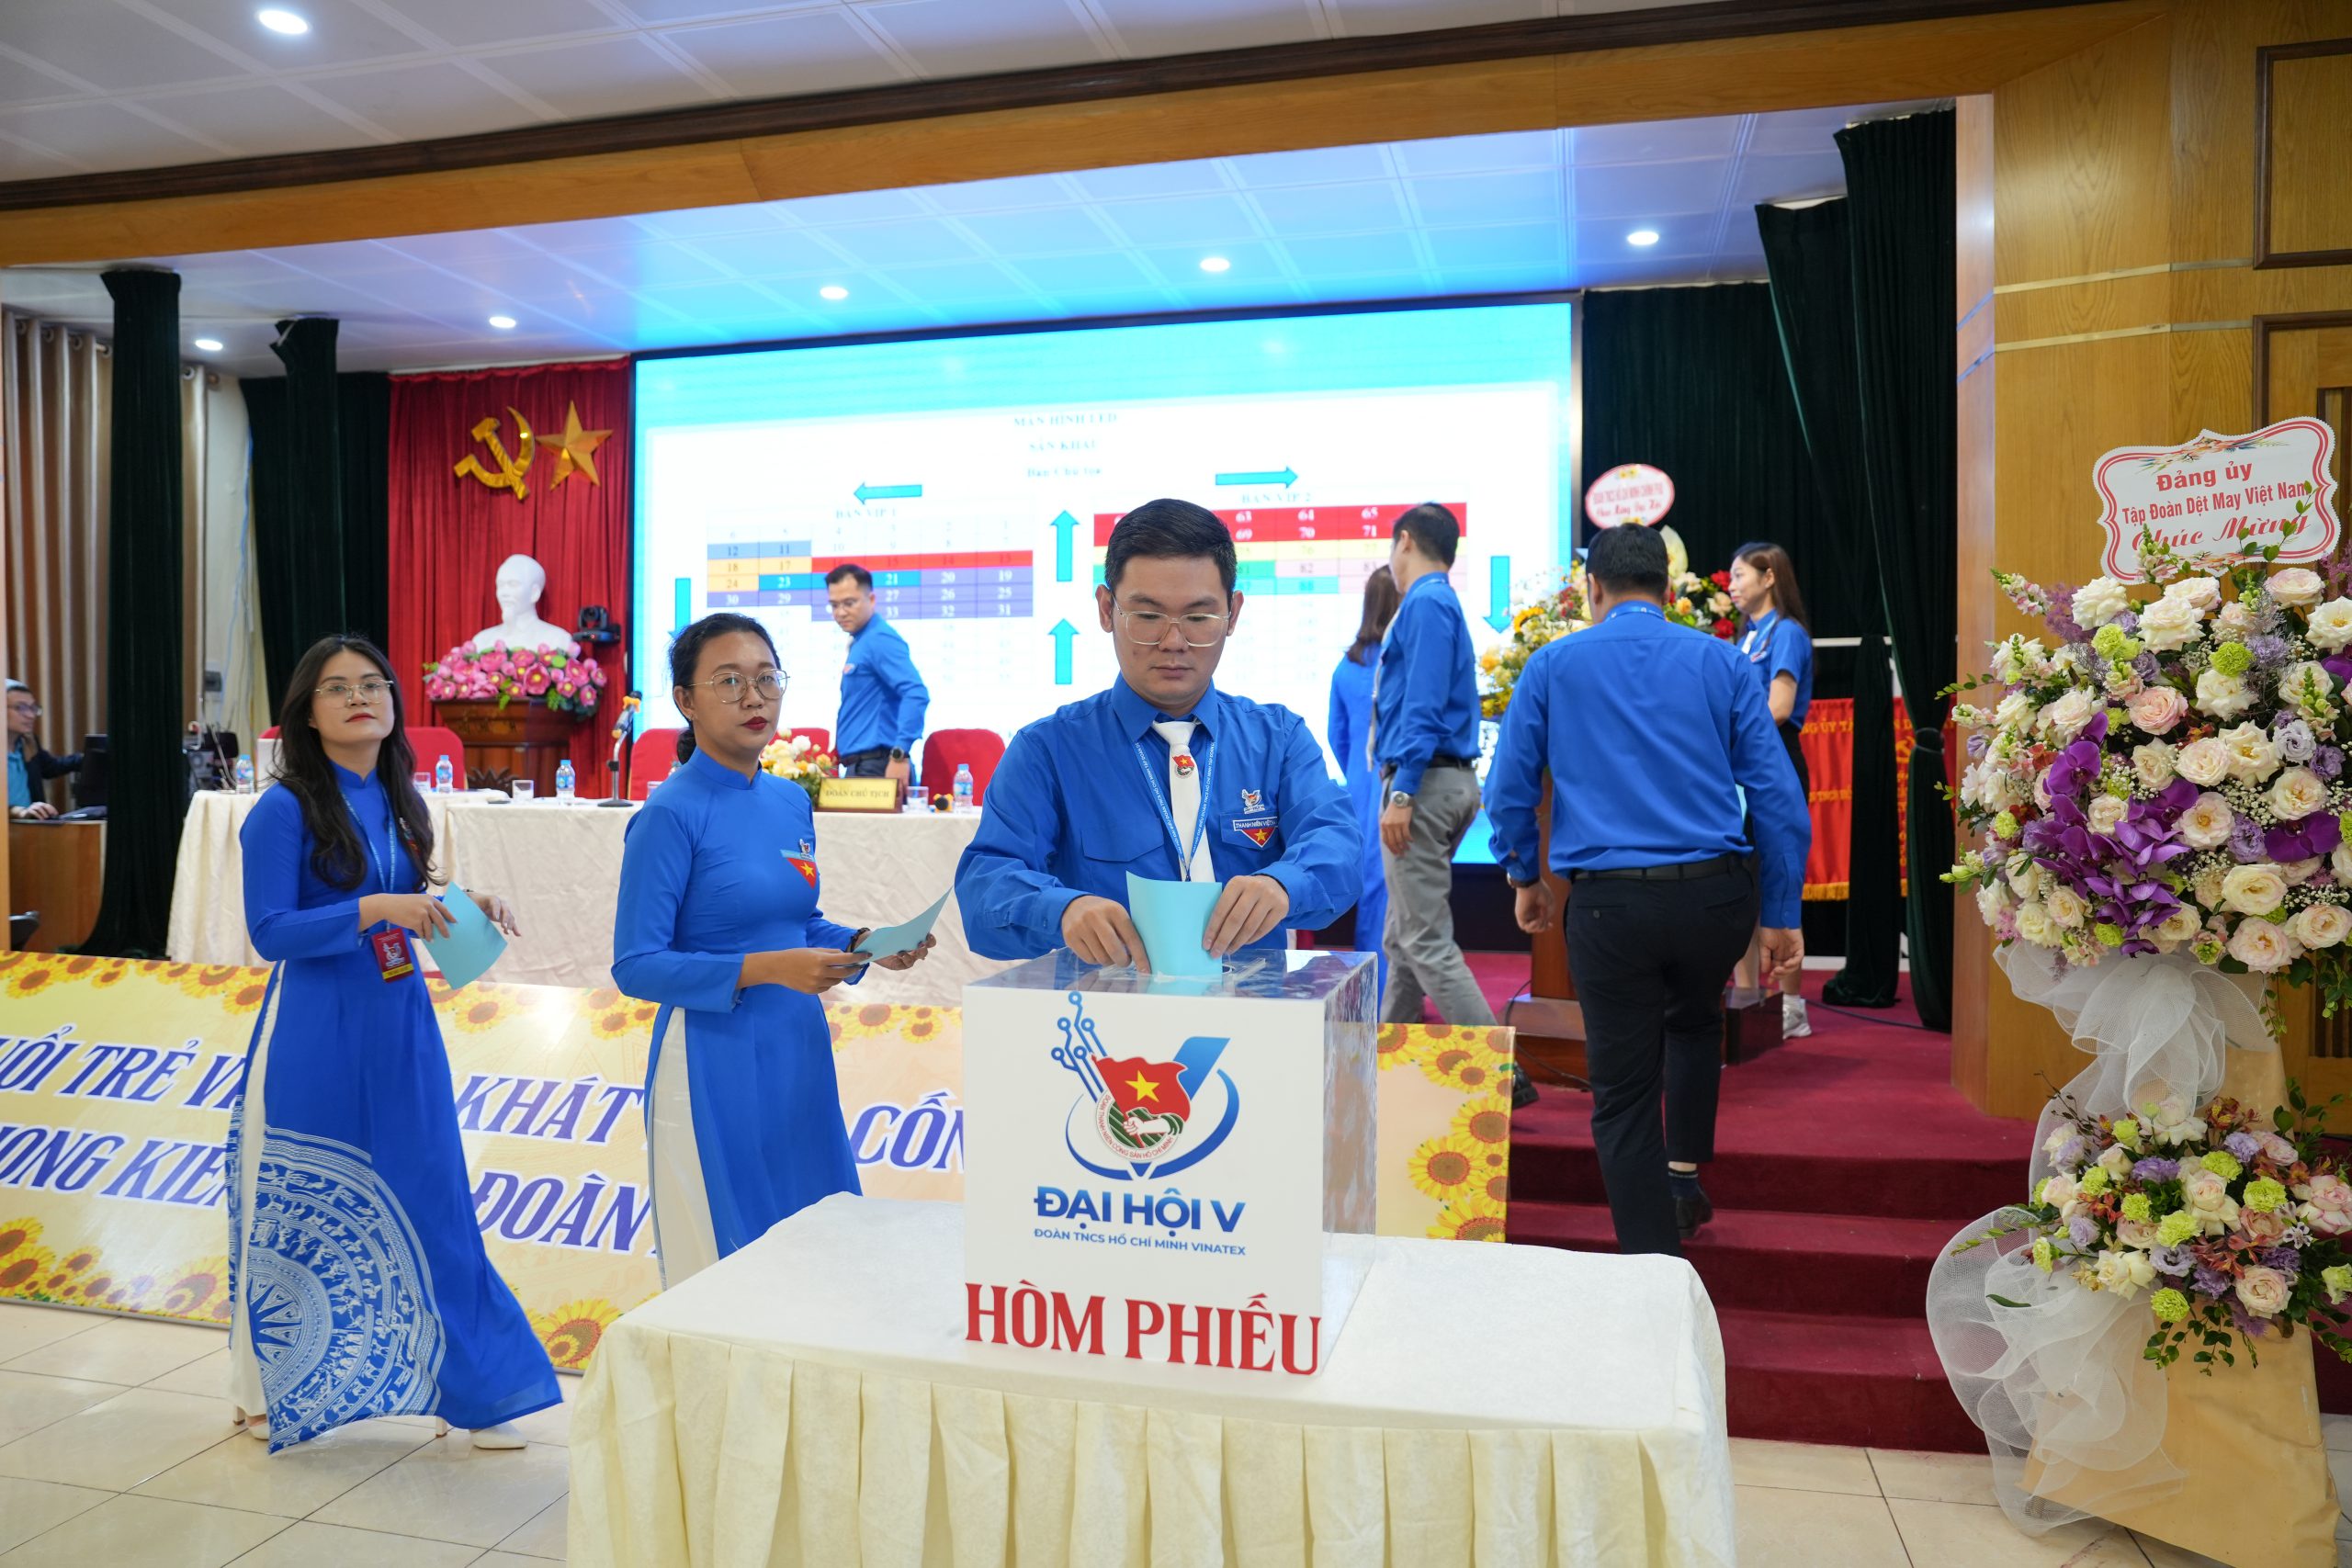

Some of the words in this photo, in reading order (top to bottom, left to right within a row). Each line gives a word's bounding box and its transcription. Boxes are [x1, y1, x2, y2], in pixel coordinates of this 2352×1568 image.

[2156, 469, 2217, 491] Đảng
[2226, 461, 2253, 481] ủy
[2122, 507, 2146, 525] Tập
[2150, 502, 2183, 520] Đoàn
[2187, 496, 2208, 516] Dệt
[2213, 491, 2241, 512] May
[2245, 487, 2274, 507] Việt
[2278, 481, 2311, 498] Nam
[1298, 526, 1316, 538] 70
[1362, 525, 1377, 537] 71
[727, 546, 739, 557] 12
[727, 562, 739, 572] 18
[779, 560, 791, 570] 17
[1300, 563, 1313, 574] 82
[727, 579, 738, 589] 24
[885, 573, 899, 585] 21
[941, 571, 956, 584] 20
[999, 570, 1012, 582] 19
[886, 589, 899, 603] 27
[941, 588, 956, 601] 26
[998, 604, 1012, 616] 31
[60, 1040, 198, 1101] TRẺ
[455, 1076, 645, 1143] KHÁT
[1034, 1186, 1112, 1230] ĐẠI
[1123, 1188, 1201, 1237] HỘI
[1210, 1200, 1246, 1233] V
[1034, 1227, 1070, 1240] ĐOÀN
[1073, 1232, 1105, 1244] TNCS
[1130, 1236, 1151, 1247] CHÍ
[1155, 1239, 1188, 1250] MINH
[1191, 1242, 1246, 1256] VINATEX
[965, 1280, 1106, 1356] HÒM
[1125, 1293, 1322, 1376] PHIẾU
